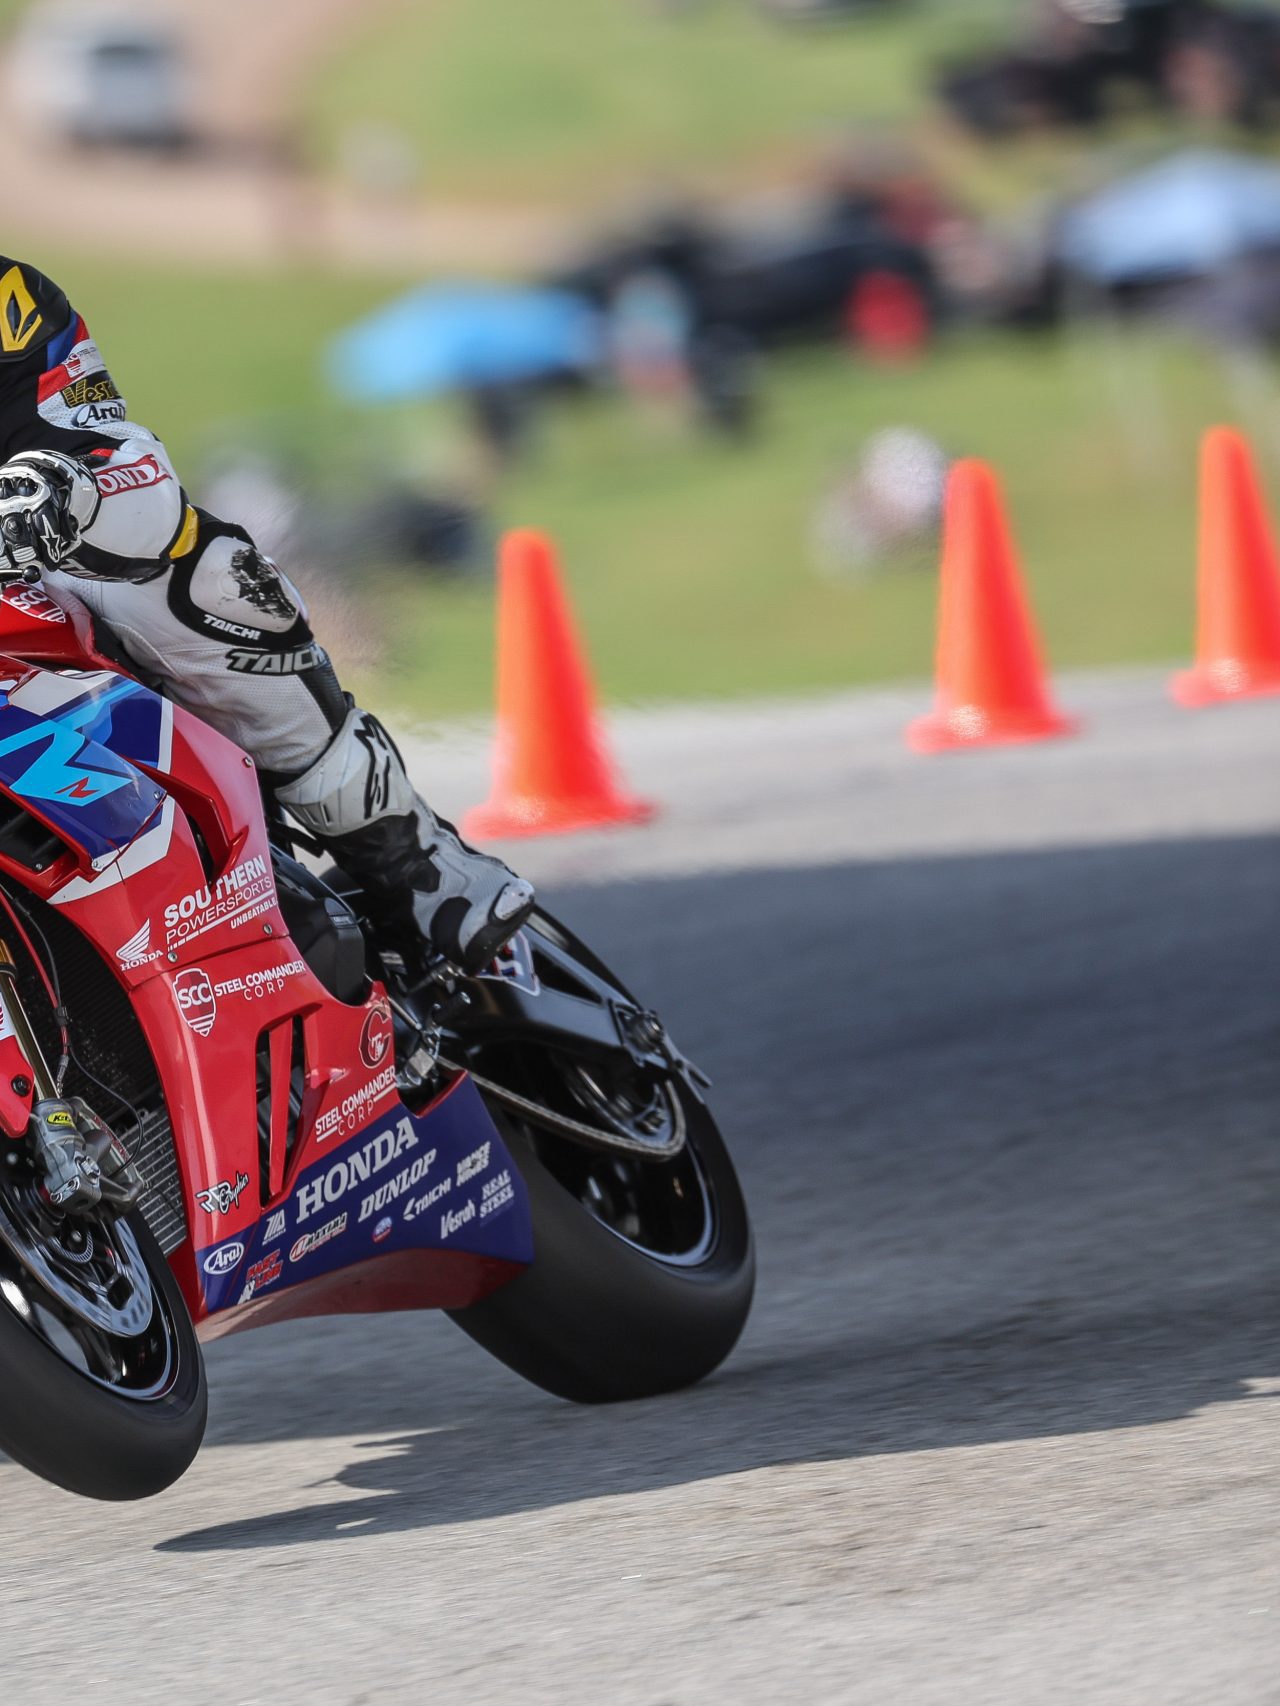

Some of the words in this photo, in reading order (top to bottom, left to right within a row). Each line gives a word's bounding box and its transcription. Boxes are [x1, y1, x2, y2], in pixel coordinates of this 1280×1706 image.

[203, 614, 261, 640] TAICHI
[164, 855, 267, 928] SOUTHERN
[166, 878, 273, 943] POWERSPORTS
[230, 897, 277, 930] UNBEATABLE
[120, 949, 164, 972] HONDA
[177, 983, 212, 1009] SCC
[214, 977, 247, 997] STEEL
[245, 960, 306, 988] COMMANDER
[243, 979, 285, 1001] CORP
[315, 1112, 343, 1137] STEEL
[341, 1065, 397, 1119] COMMANDER
[337, 1101, 376, 1136] CORP
[295, 1116, 419, 1224] HONDA
[358, 1149, 437, 1223] DUNLOP
[482, 1169, 512, 1200] REAL
[480, 1184, 515, 1219] STEEL
[209, 1246, 241, 1271] Arai
